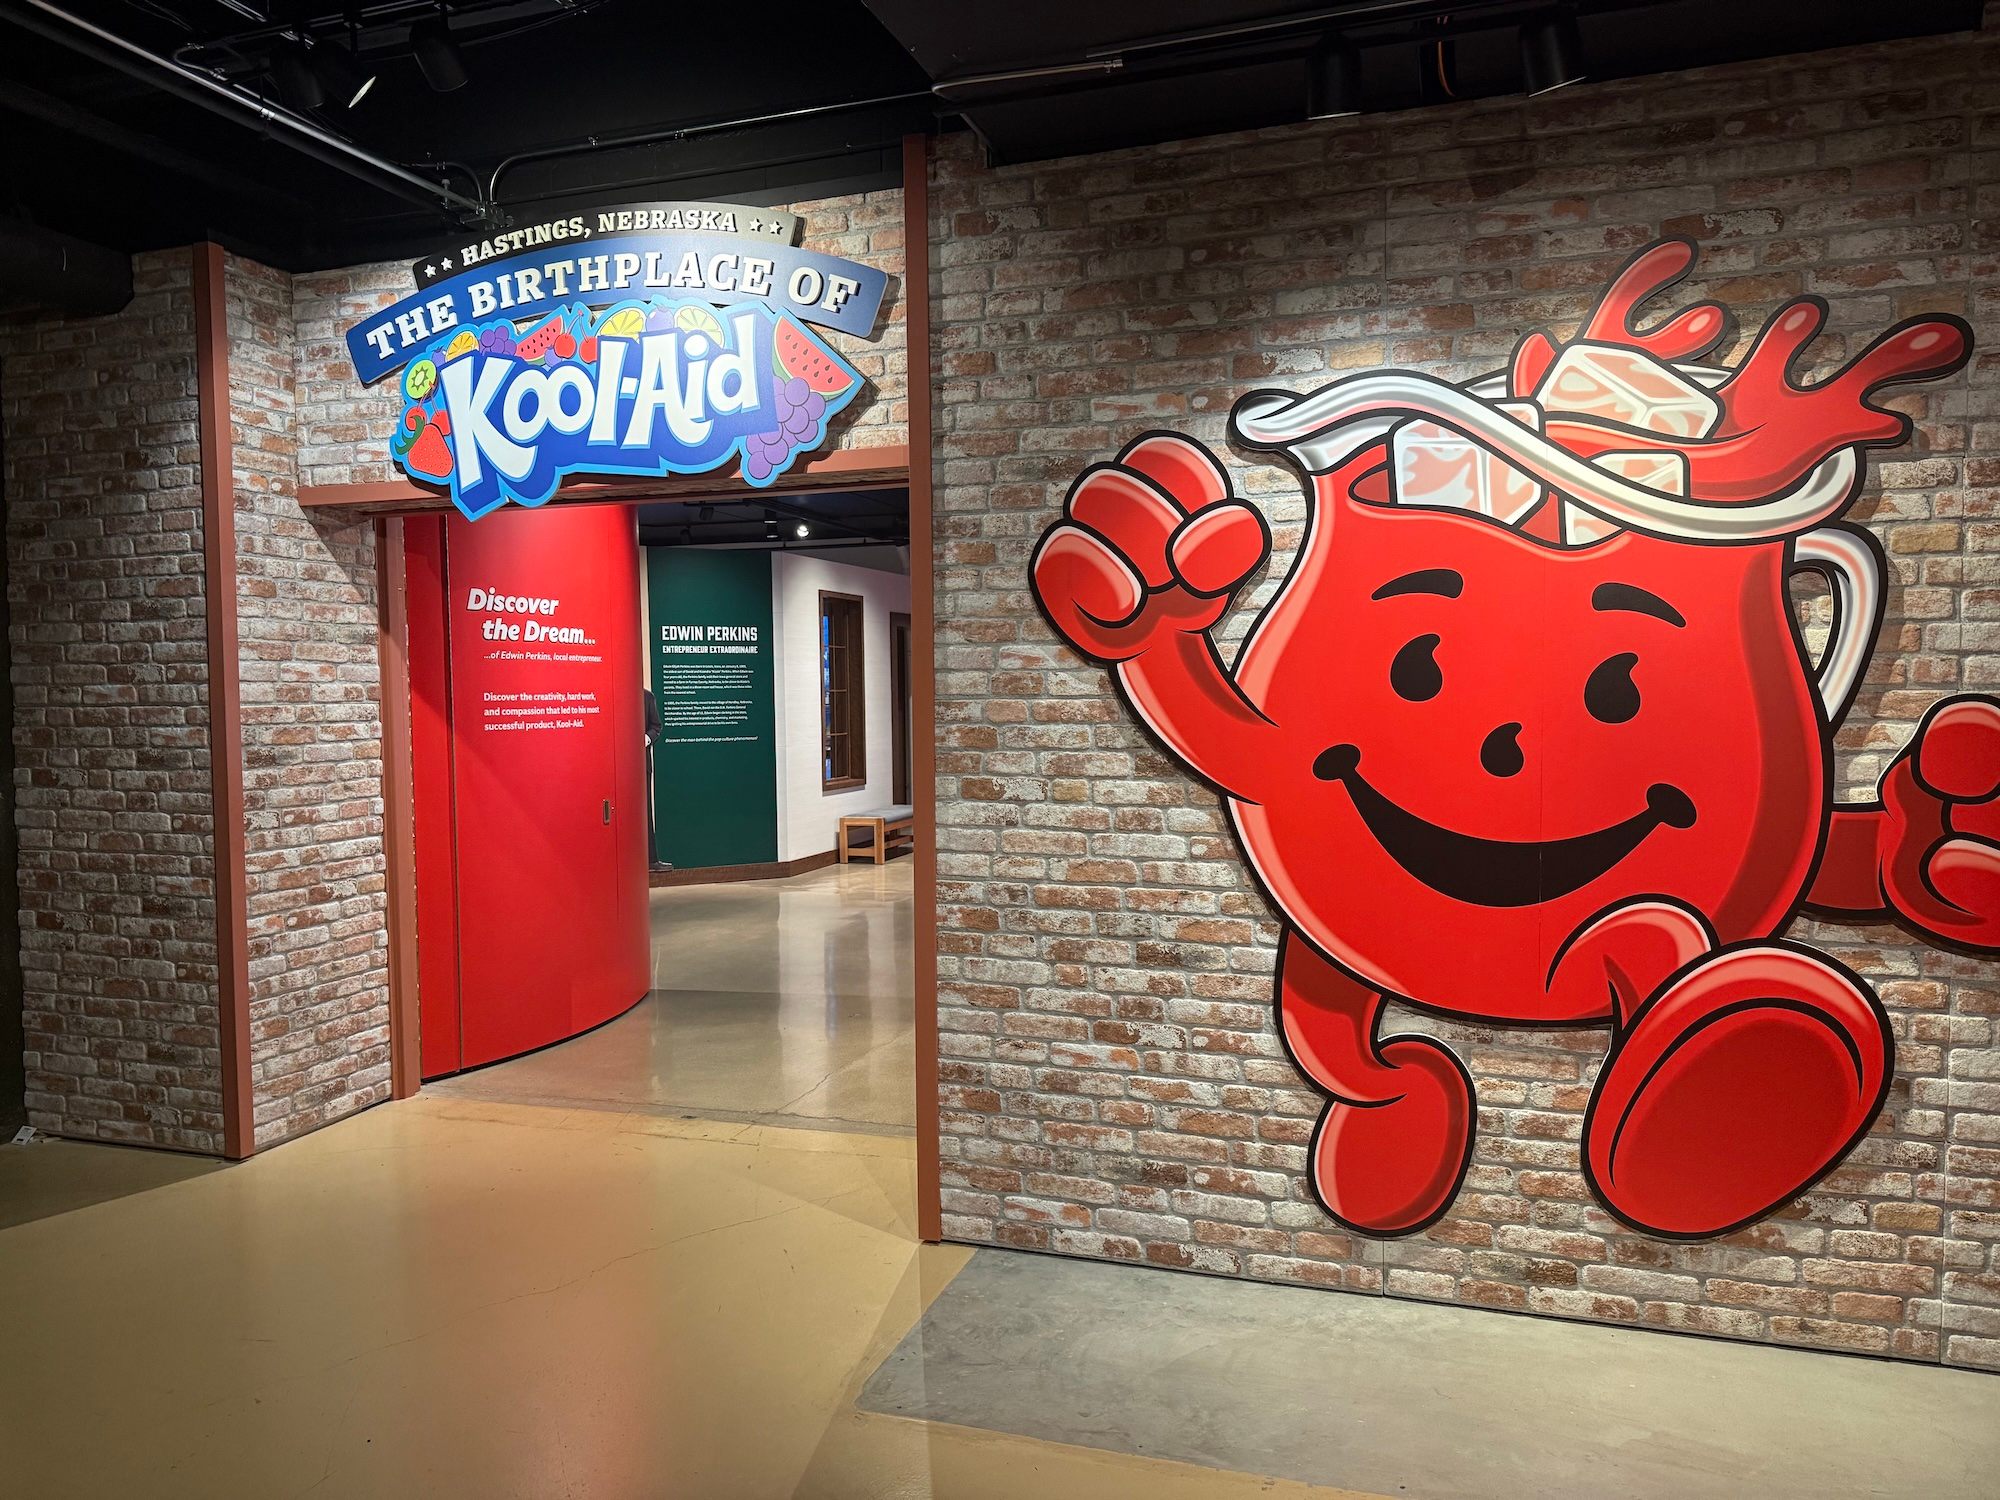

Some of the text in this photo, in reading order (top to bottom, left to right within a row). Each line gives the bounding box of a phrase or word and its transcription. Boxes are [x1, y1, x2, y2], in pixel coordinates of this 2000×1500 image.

[460, 209, 738, 267] HASTINGS, NEBRASKA
[366, 251, 862, 360] THE BIRTHPLACE OF
[440, 314, 759, 492] Kool-Aid
[467, 586, 559, 616] Discover
[482, 618, 596, 645] the Dream...
[662, 626, 758, 642] EDWIN PERKINS
[501, 651, 525, 660] Edwin
[525, 651, 553, 662] Perkins,
[553, 653, 568, 662] local
[663, 645, 759, 654] ENTREPRENEUR EXTRAORDINAIRE
[483, 692, 597, 703] Discover the creativity, hard work,
[484, 705, 600, 717] and compassion that led to his most
[484, 719, 585, 731] successful product, Kool-Aid.
